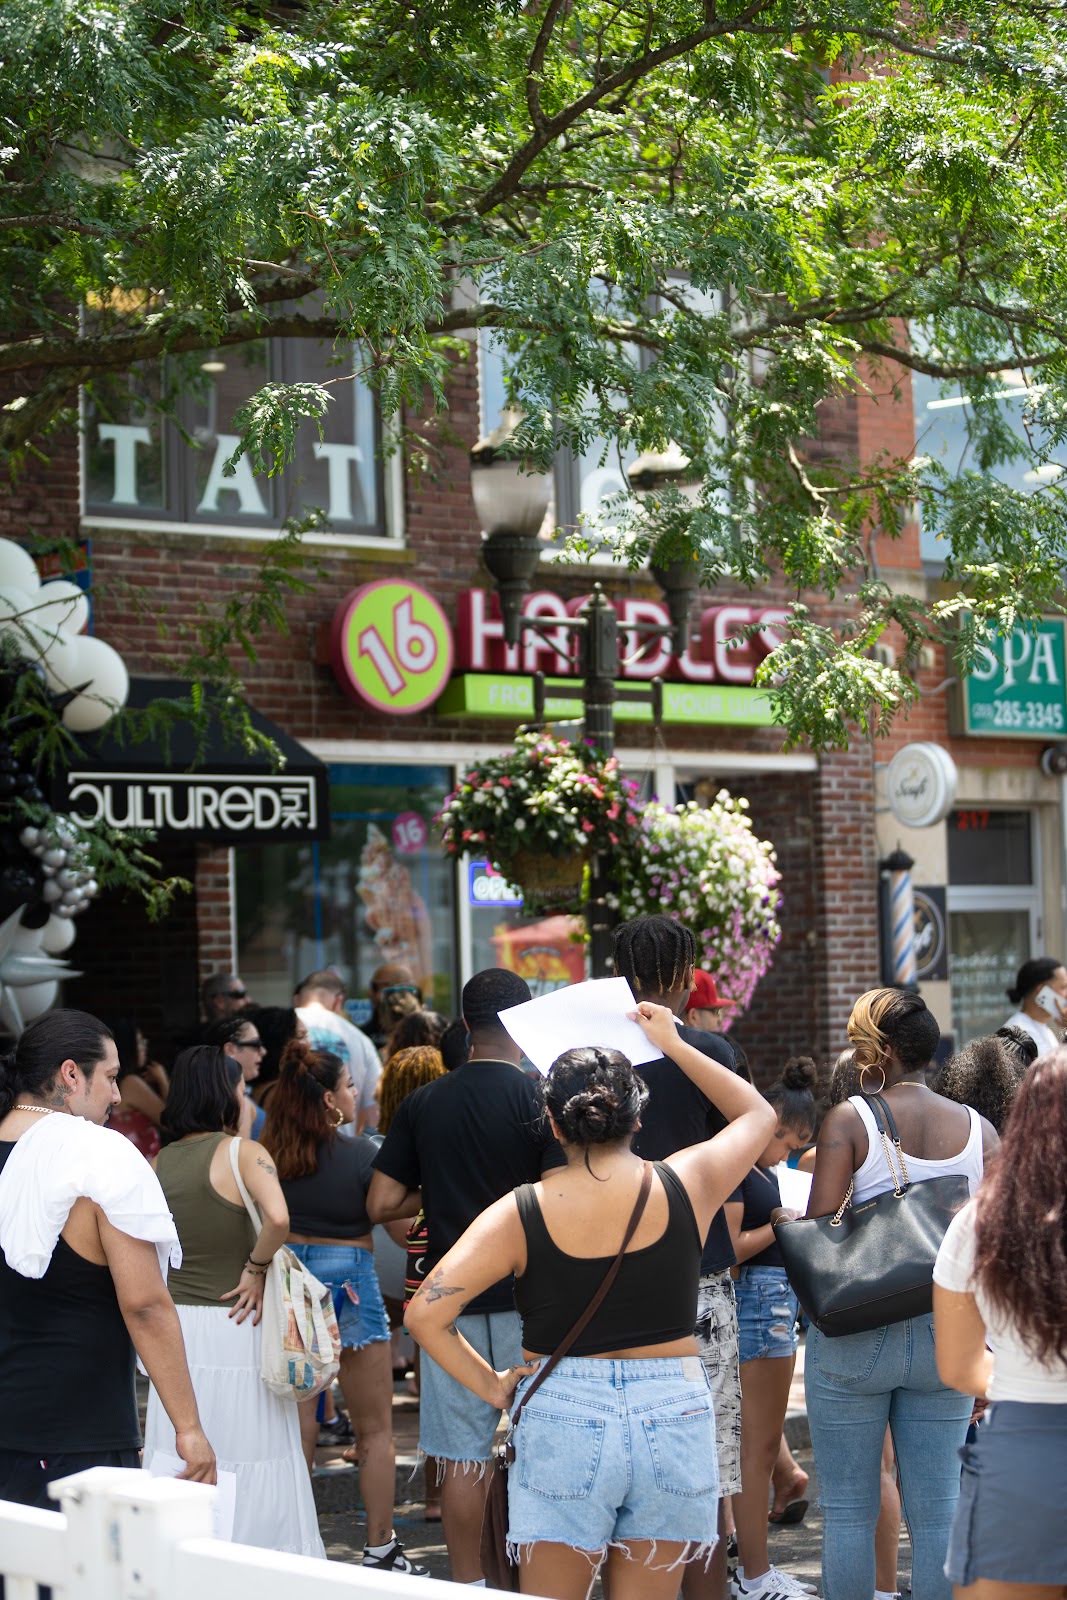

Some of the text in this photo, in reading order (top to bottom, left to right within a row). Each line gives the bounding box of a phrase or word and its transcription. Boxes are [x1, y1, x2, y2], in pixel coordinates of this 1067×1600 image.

[358, 593, 438, 697] 16
[972, 626, 1060, 696] SPA
[993, 699, 1064, 730] 285-3345
[396, 819, 423, 846] 16
